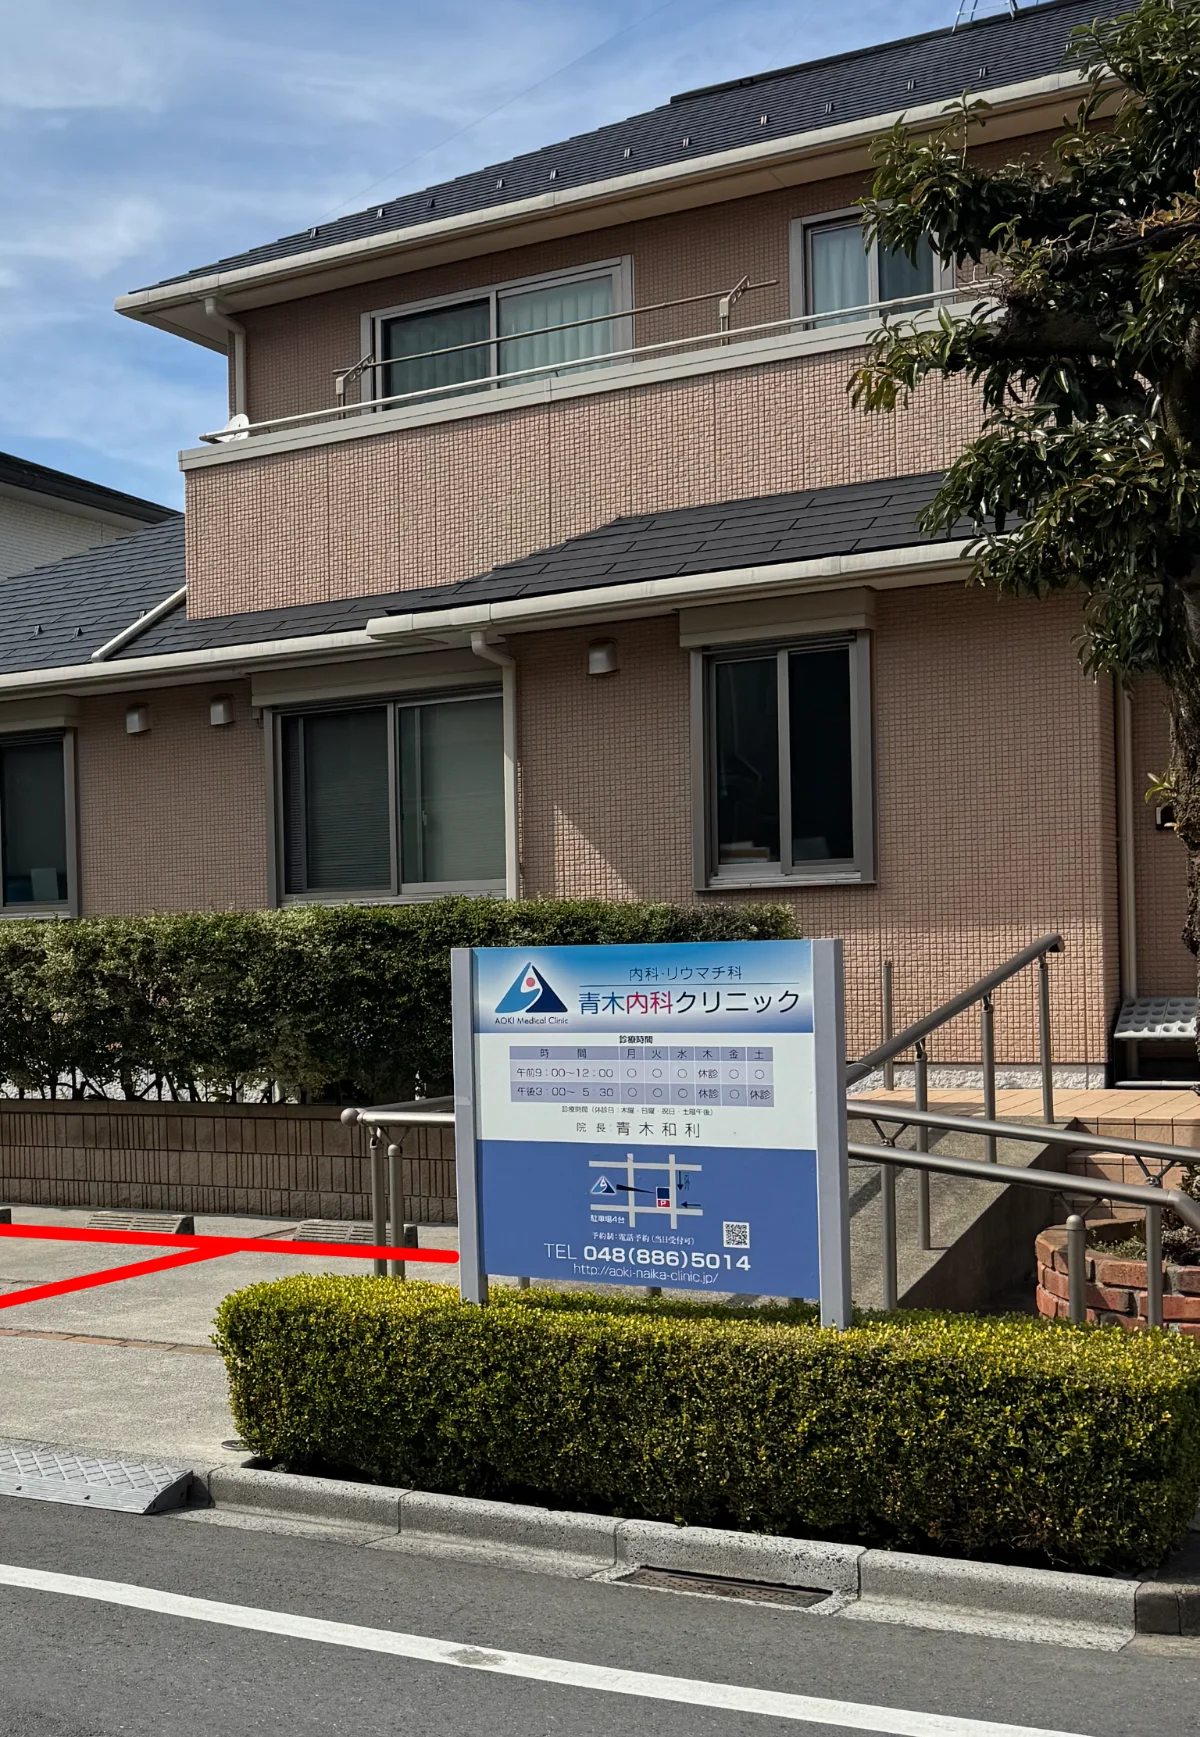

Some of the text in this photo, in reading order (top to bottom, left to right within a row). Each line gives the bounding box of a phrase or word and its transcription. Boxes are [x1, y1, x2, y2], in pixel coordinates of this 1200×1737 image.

[579, 991, 799, 1015] 青木内科クリニック
[495, 1016, 568, 1024] AOKI Medical Clinic
[619, 1035, 653, 1044] 診療時間
[626, 1048, 636, 1059] 月
[651, 1049, 662, 1059] 火
[676, 1049, 688, 1059] 水
[702, 1049, 713, 1060] 木
[728, 1049, 739, 1060] 金
[754, 1050, 764, 1060] 土
[698, 1068, 719, 1079] 休診
[698, 1088, 719, 1099] 休診
[749, 1090, 771, 1100] 休診
[590, 1214, 625, 1224] 駐車場4台
[544, 1243, 751, 1271] TEL 048(886)5014
[573, 1263, 719, 1285] http://aoki-naika-clinic.jp/
